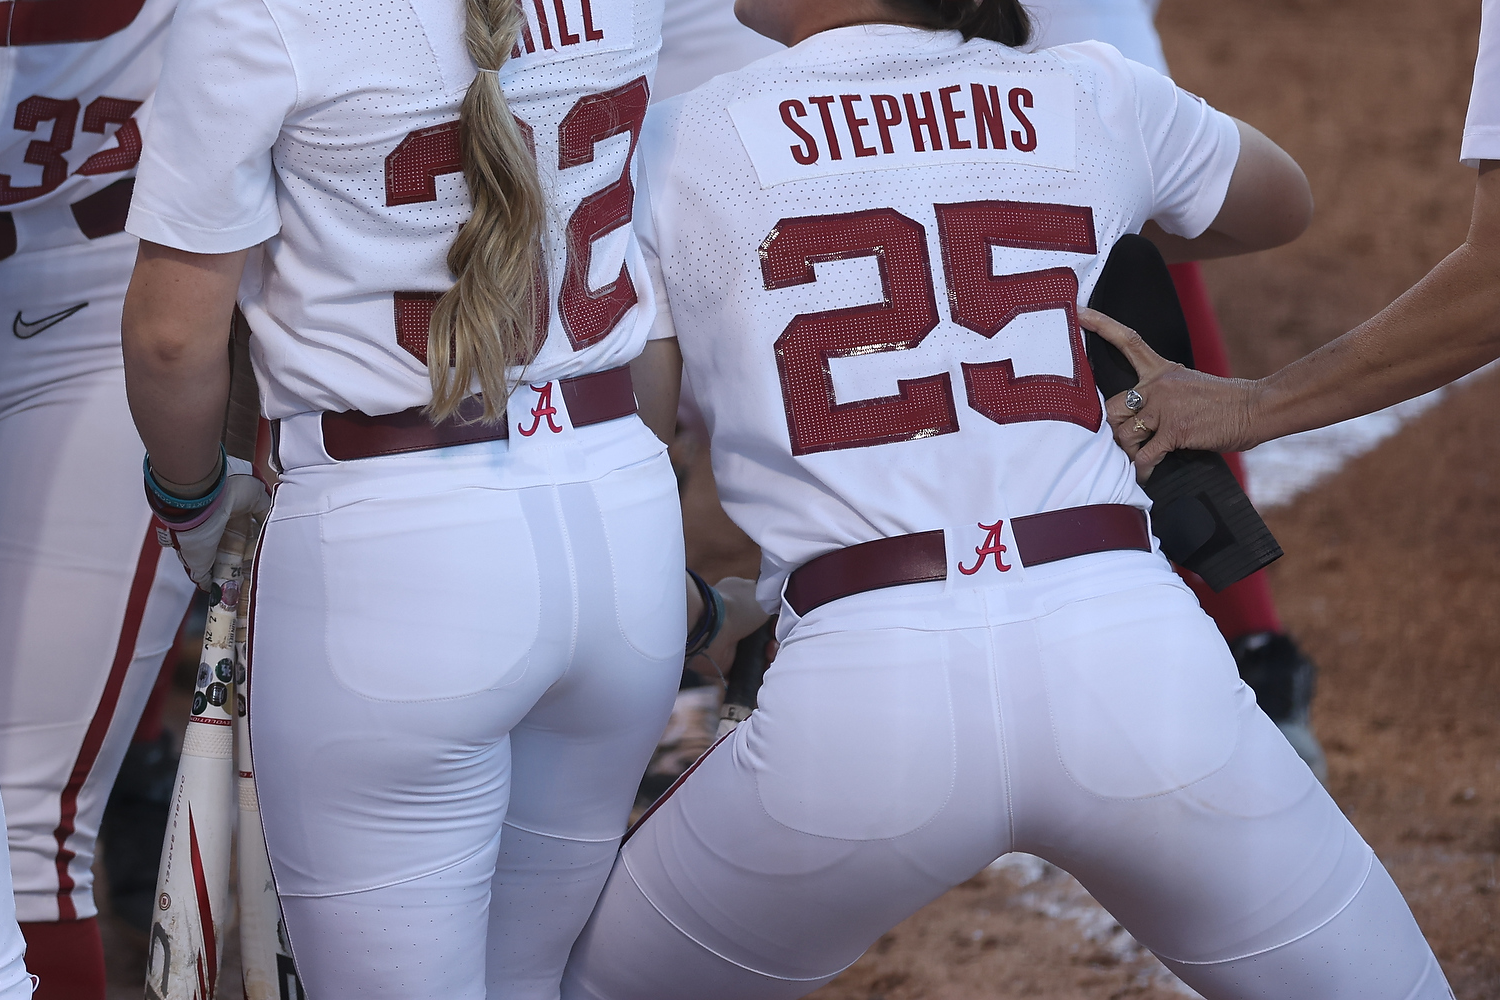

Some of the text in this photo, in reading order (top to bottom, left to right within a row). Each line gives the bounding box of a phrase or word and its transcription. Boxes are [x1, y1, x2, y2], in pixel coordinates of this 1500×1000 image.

[778, 82, 1039, 166] STEPHENS
[757, 198, 1104, 457] 25
[517, 382, 564, 437] A
[957, 519, 1013, 577] A
